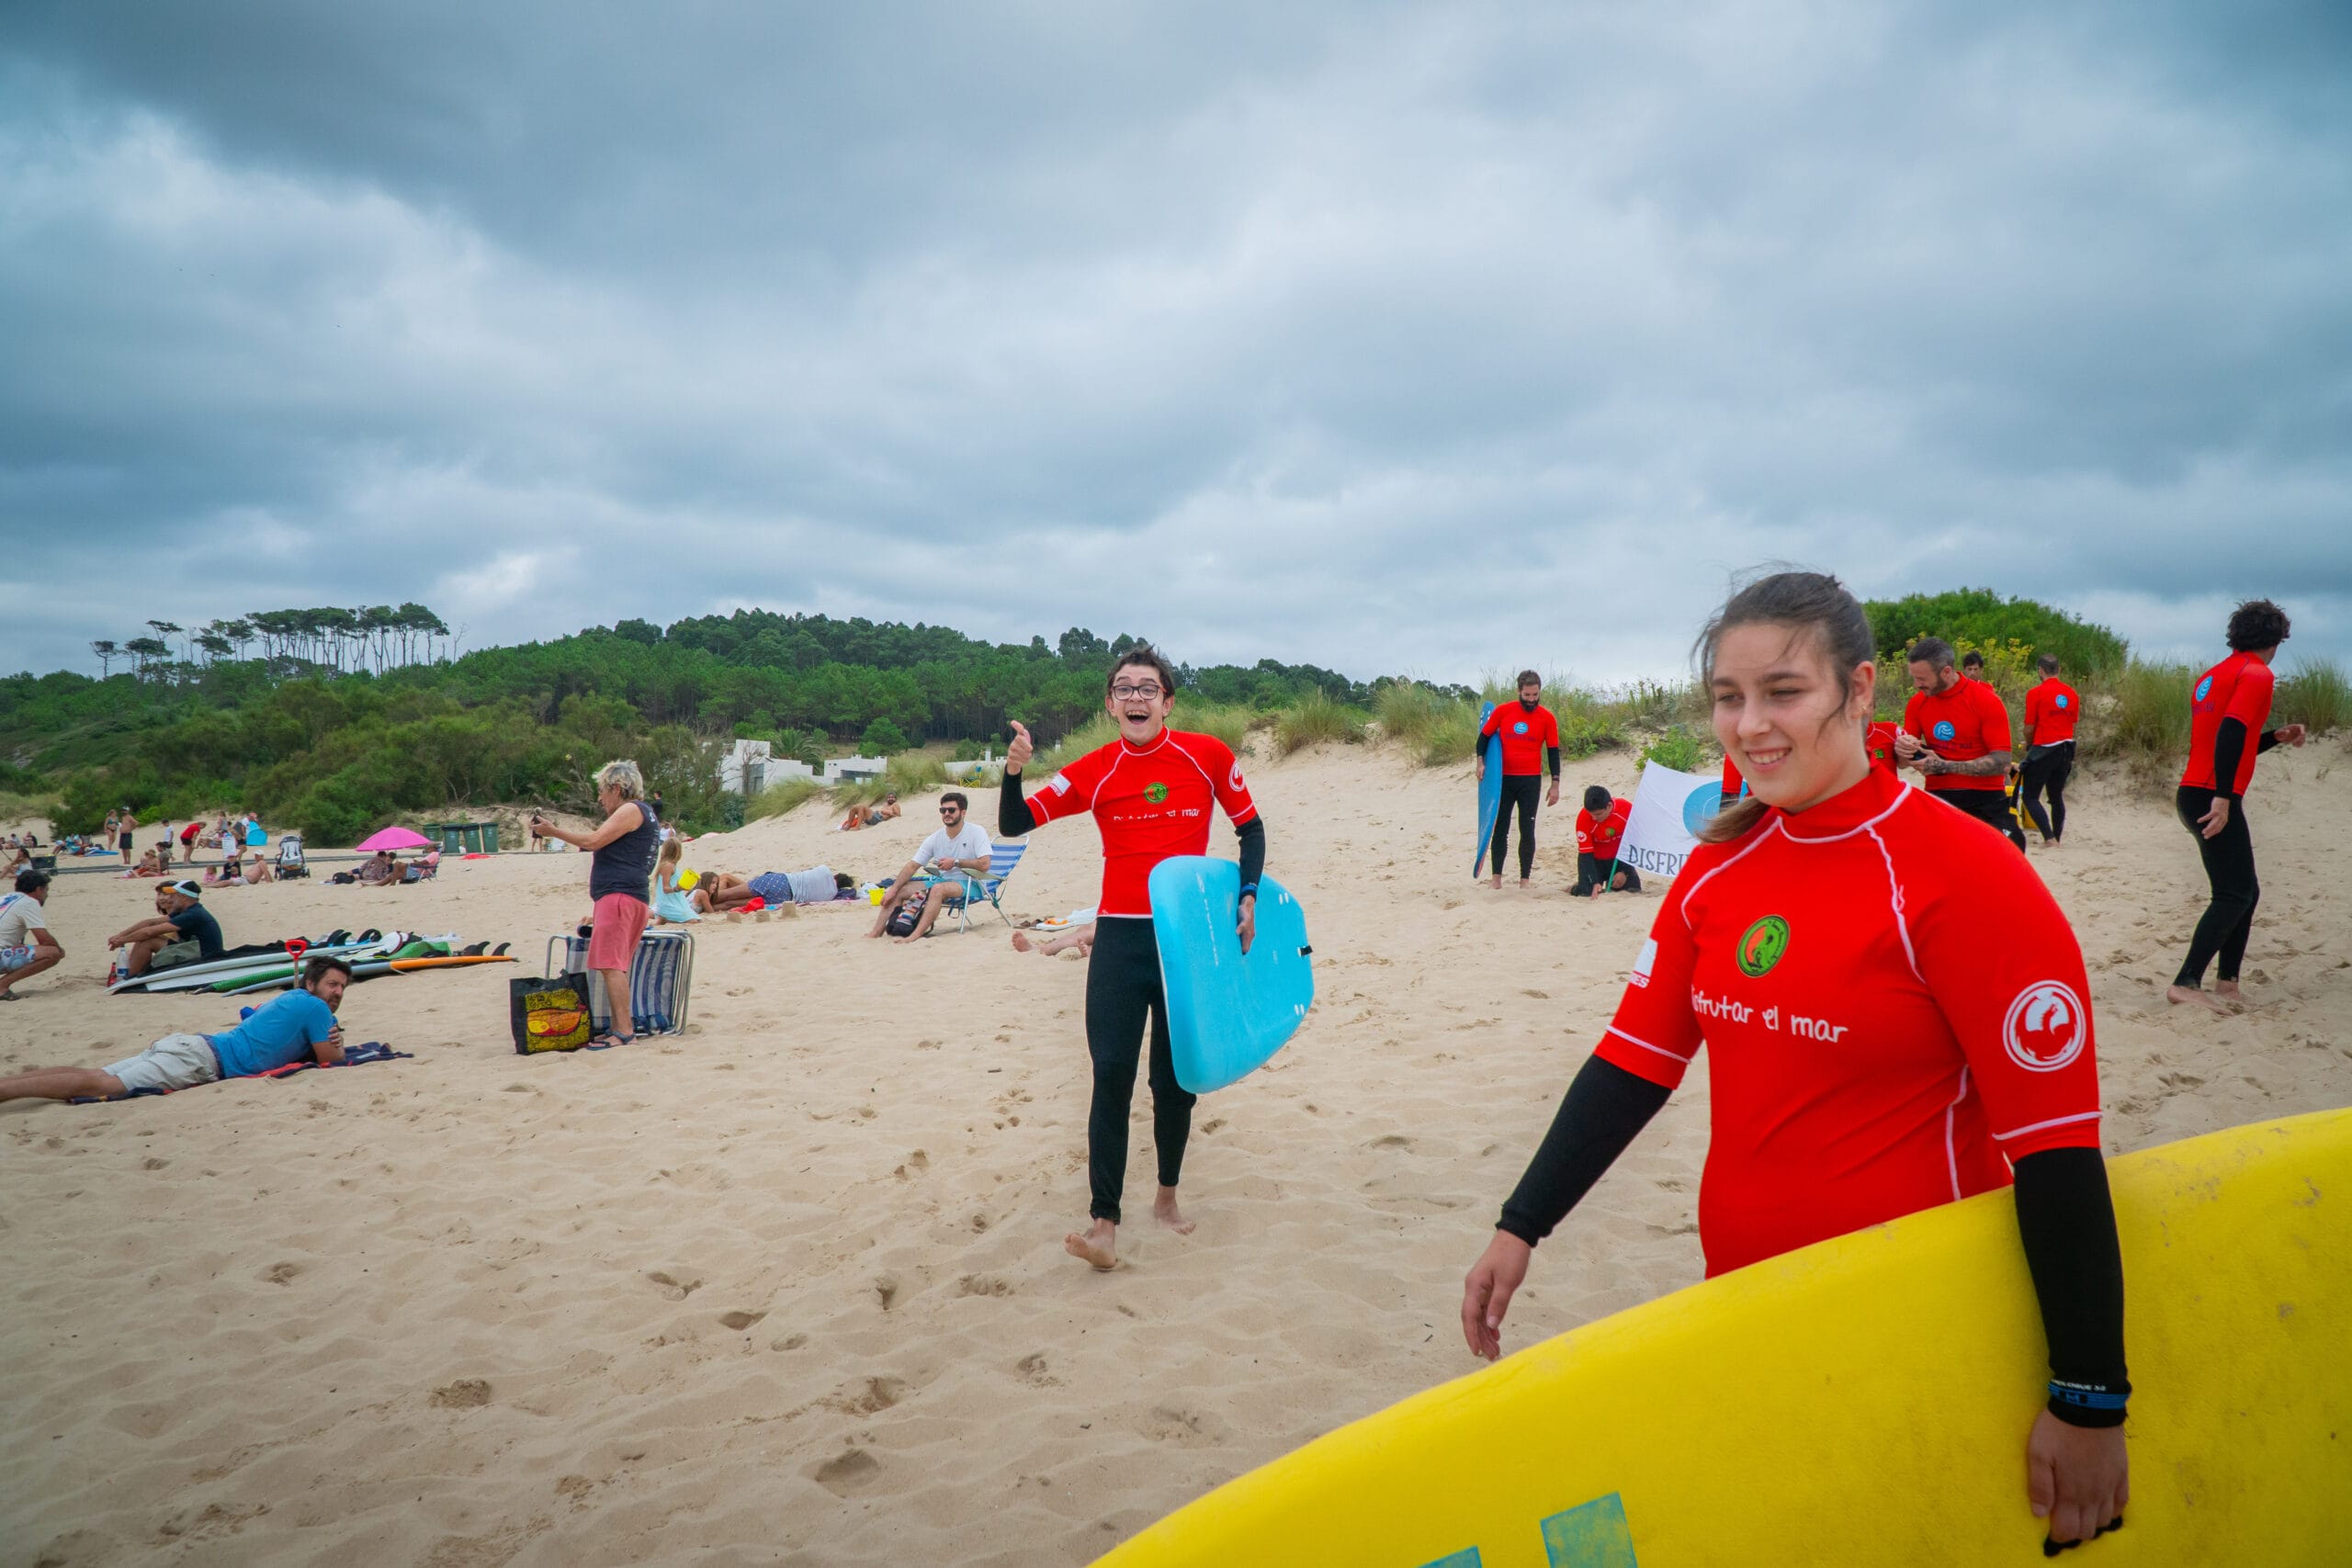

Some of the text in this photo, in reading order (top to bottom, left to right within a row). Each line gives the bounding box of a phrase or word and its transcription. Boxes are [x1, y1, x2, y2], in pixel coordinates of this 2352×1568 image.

[1690, 984, 1849, 1043] isfrutar el mar
